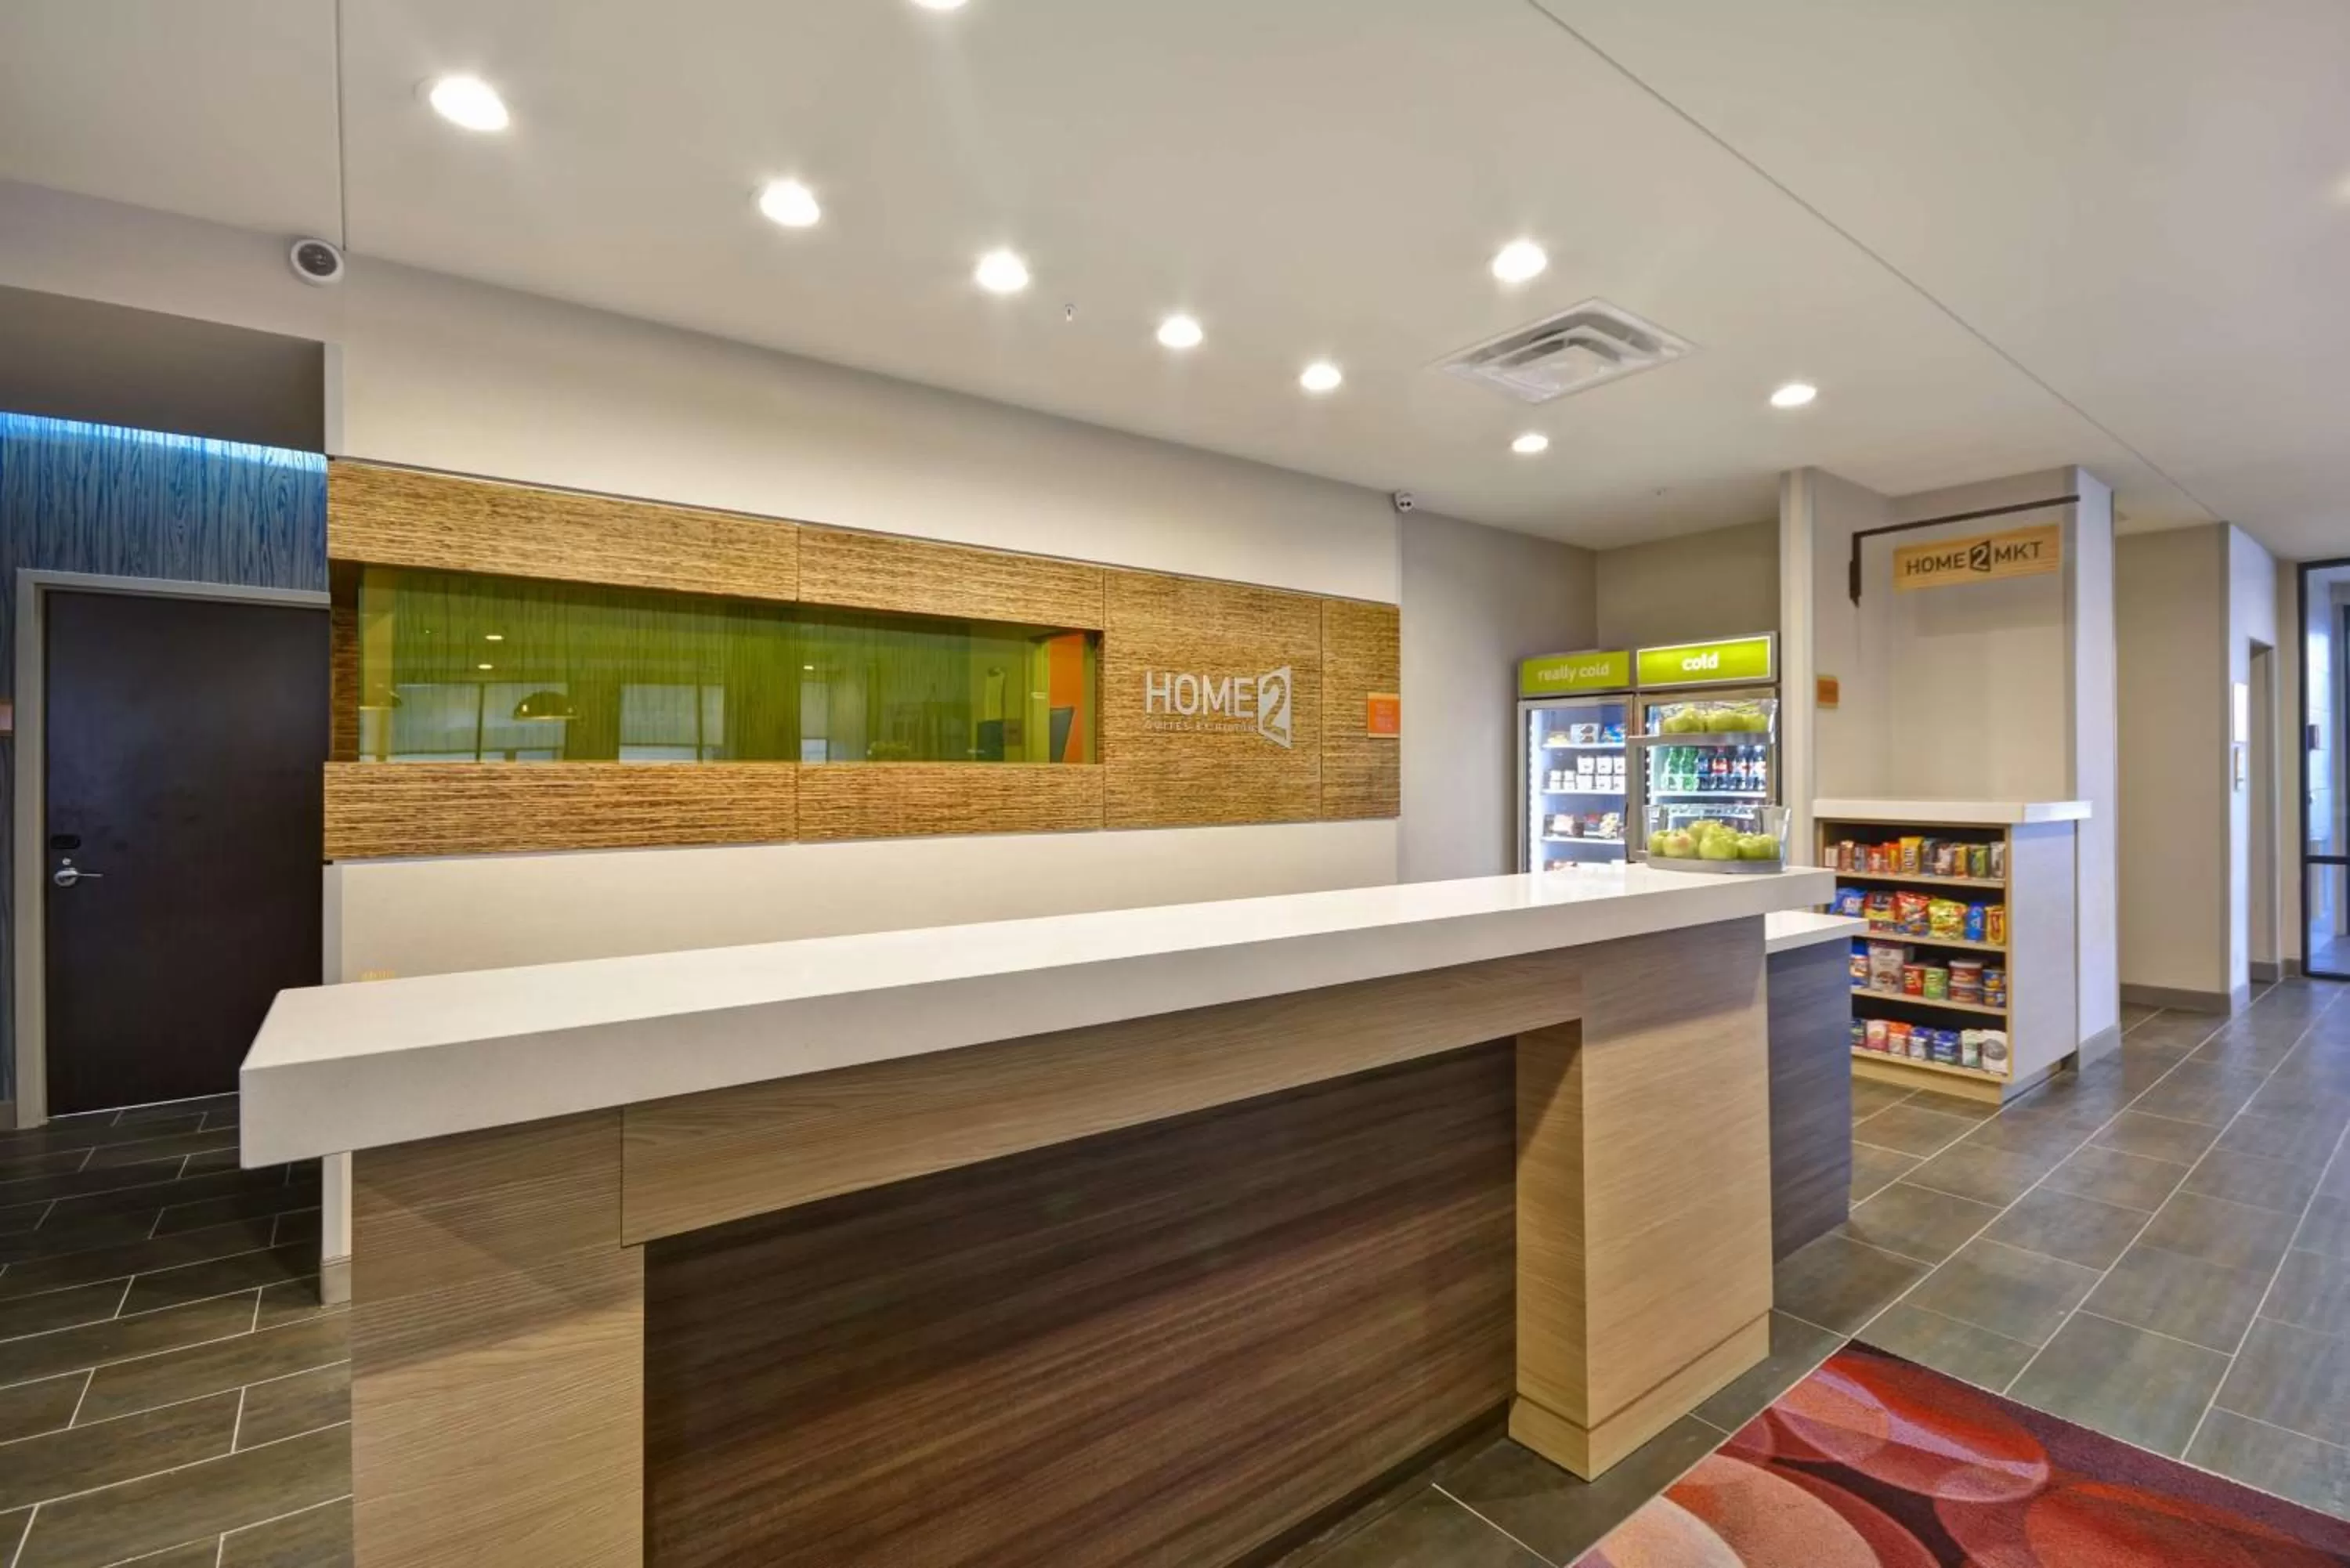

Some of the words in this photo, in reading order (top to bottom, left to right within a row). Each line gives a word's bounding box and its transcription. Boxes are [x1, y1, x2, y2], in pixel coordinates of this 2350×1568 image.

[1681, 651, 1719, 671] cold
[1538, 663, 1577, 683] really
[1579, 662, 1610, 677] cold
